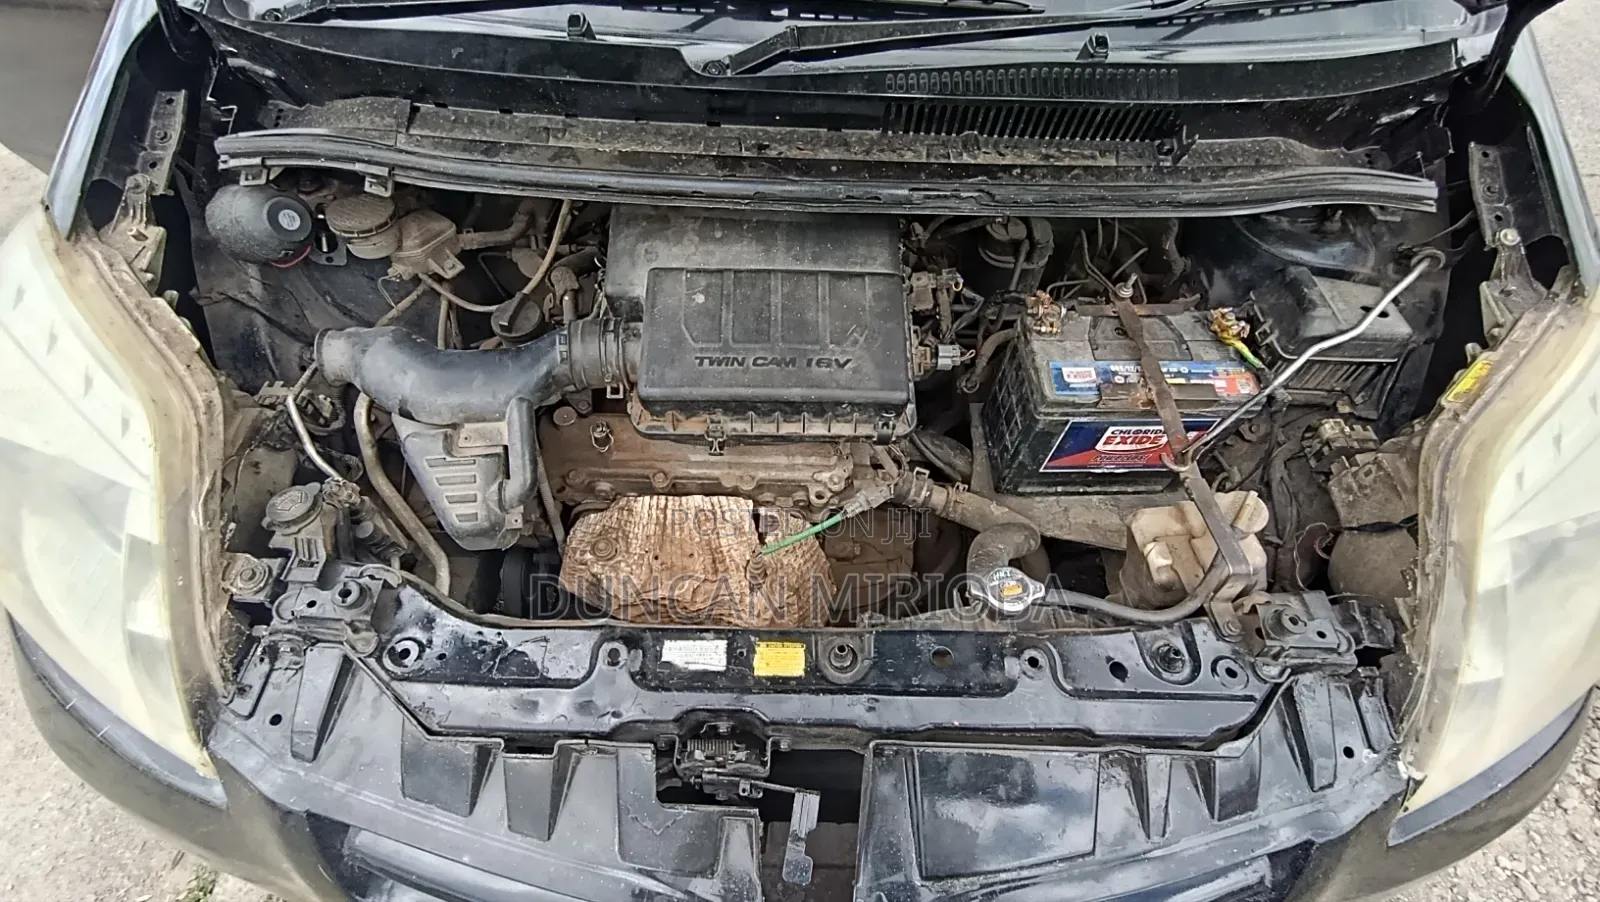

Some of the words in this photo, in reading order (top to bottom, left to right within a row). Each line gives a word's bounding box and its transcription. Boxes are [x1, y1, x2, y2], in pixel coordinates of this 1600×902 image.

[694, 356, 746, 367] TWIN
[752, 356, 797, 368] CAM
[806, 357, 853, 369] 16V
[1102, 435, 1163, 446] EXIDE
